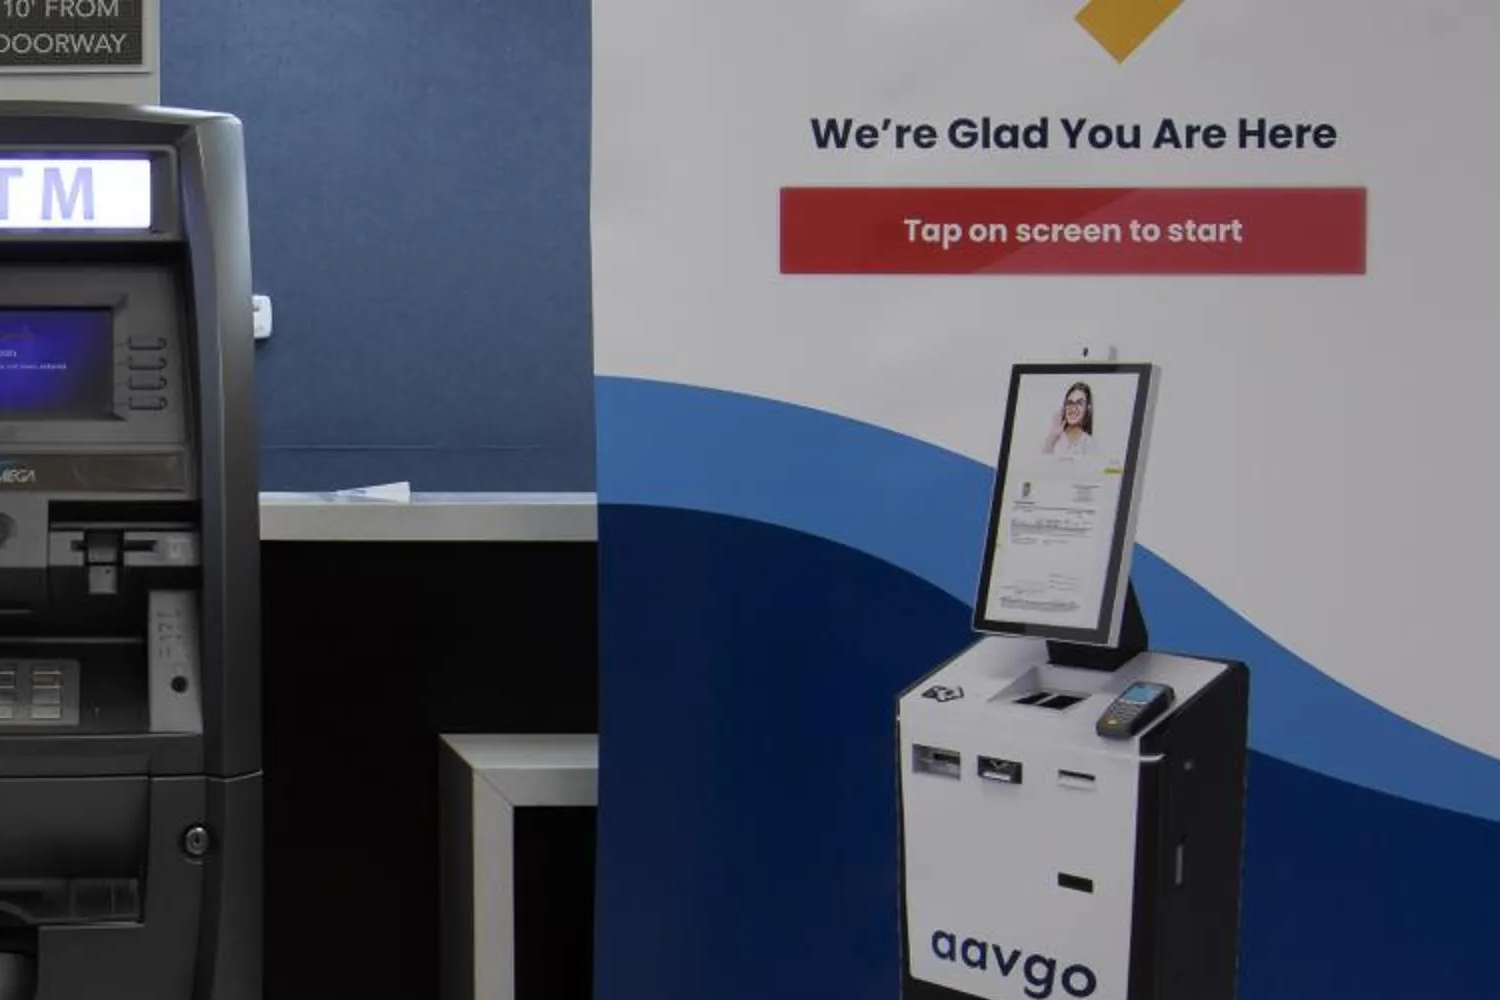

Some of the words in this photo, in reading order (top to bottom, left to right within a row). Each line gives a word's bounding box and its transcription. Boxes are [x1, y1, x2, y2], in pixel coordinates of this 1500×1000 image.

[3, 0, 37, 18] 10'
[45, 0, 120, 18] FROM
[948, 116, 1049, 150] Glad
[1060, 117, 1142, 150] You
[1152, 117, 1227, 150] Are
[1238, 117, 1338, 150] Here
[903, 218, 963, 250] Tap
[969, 223, 1008, 243] on
[1015, 223, 1122, 243] screen
[1129, 219, 1161, 243] to
[1168, 219, 1244, 243] start
[931, 929, 1097, 1000] aavgo
